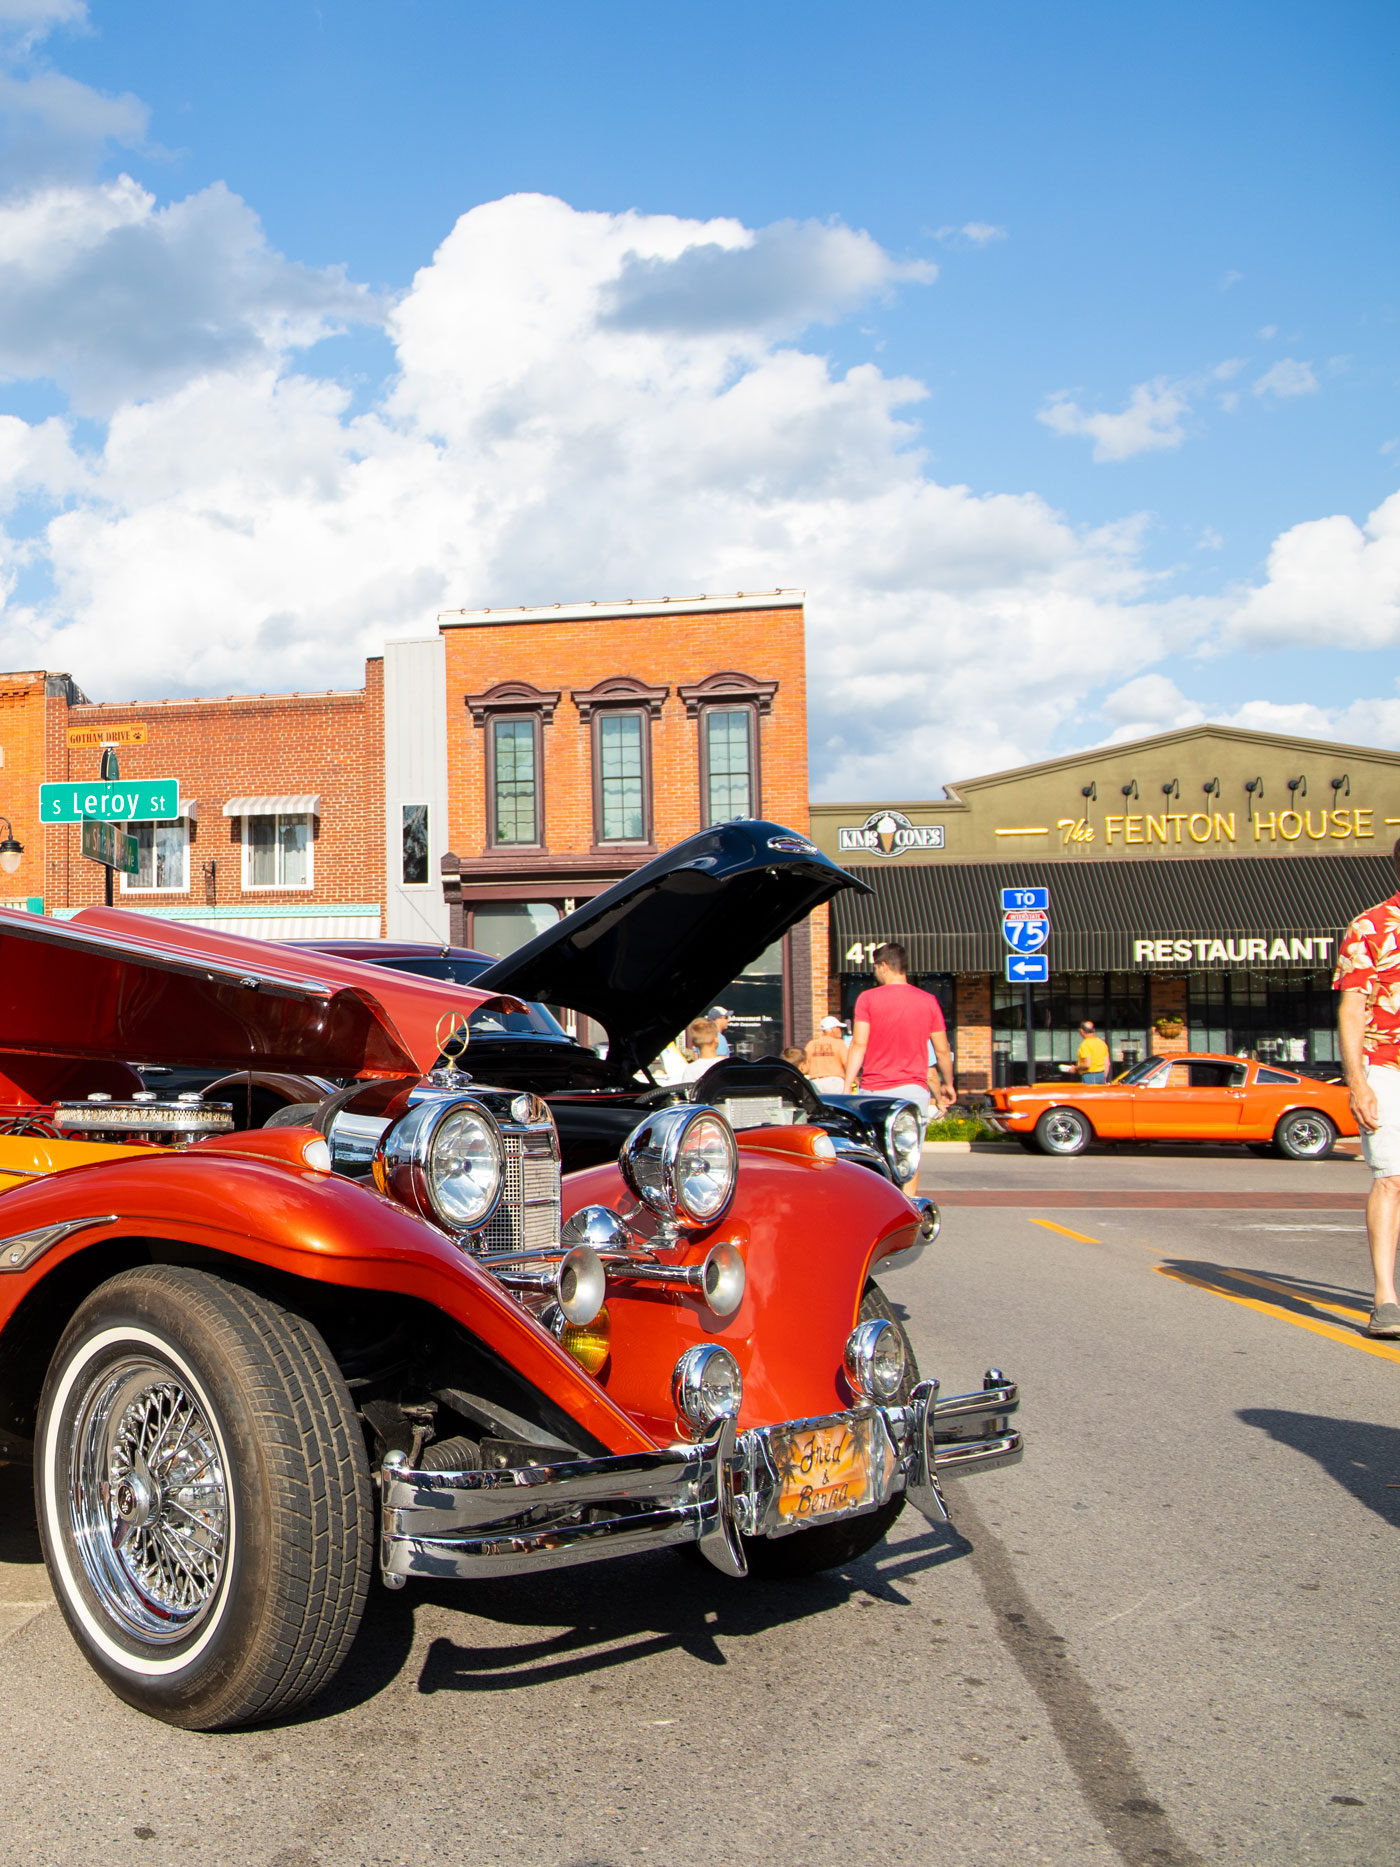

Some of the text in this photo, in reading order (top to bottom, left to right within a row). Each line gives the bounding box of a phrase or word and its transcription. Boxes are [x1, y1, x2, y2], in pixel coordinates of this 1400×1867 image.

[70, 730, 131, 744] GOTHAM DRIVE
[73, 792, 139, 819] Leroy
[150, 796, 166, 812] St
[894, 828, 941, 846] CONES
[1056, 809, 1375, 845] The FENTON HOUSE
[1014, 892, 1035, 906] TO
[1010, 913, 1041, 921] INTERSTATE
[1006, 921, 1045, 945] 75
[845, 942, 888, 964] 41
[1134, 937, 1334, 963] RESTAURANT
